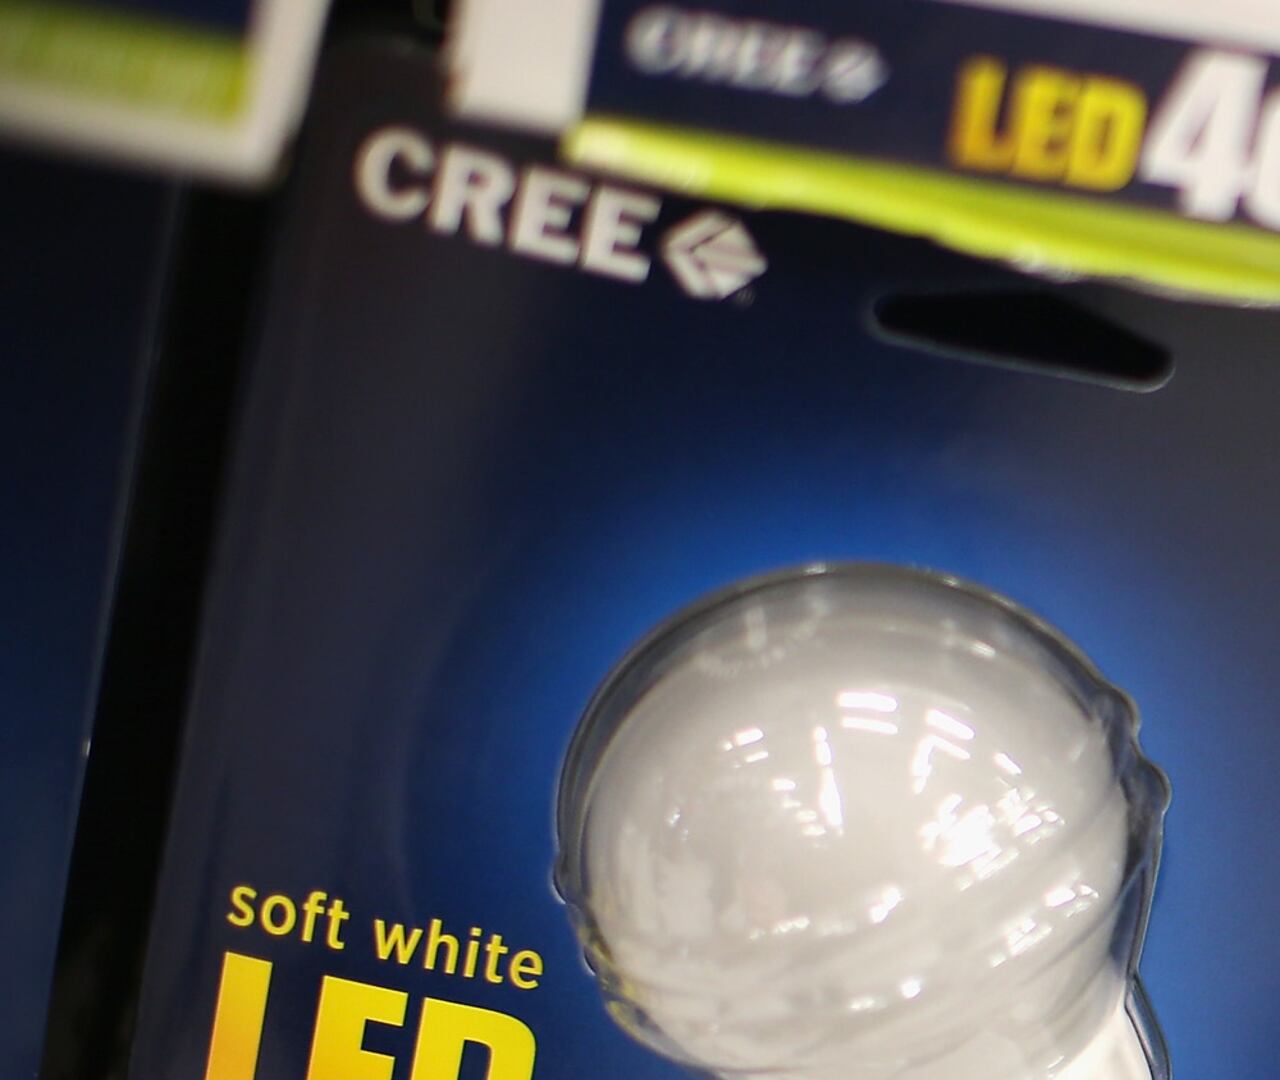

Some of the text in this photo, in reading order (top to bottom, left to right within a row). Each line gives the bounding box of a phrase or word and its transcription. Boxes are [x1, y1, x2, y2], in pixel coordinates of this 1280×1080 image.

[626, 5, 823, 97] CREE
[952, 57, 1142, 190] LED
[355, 125, 661, 283] CREE
[226, 885, 544, 990] soft white
